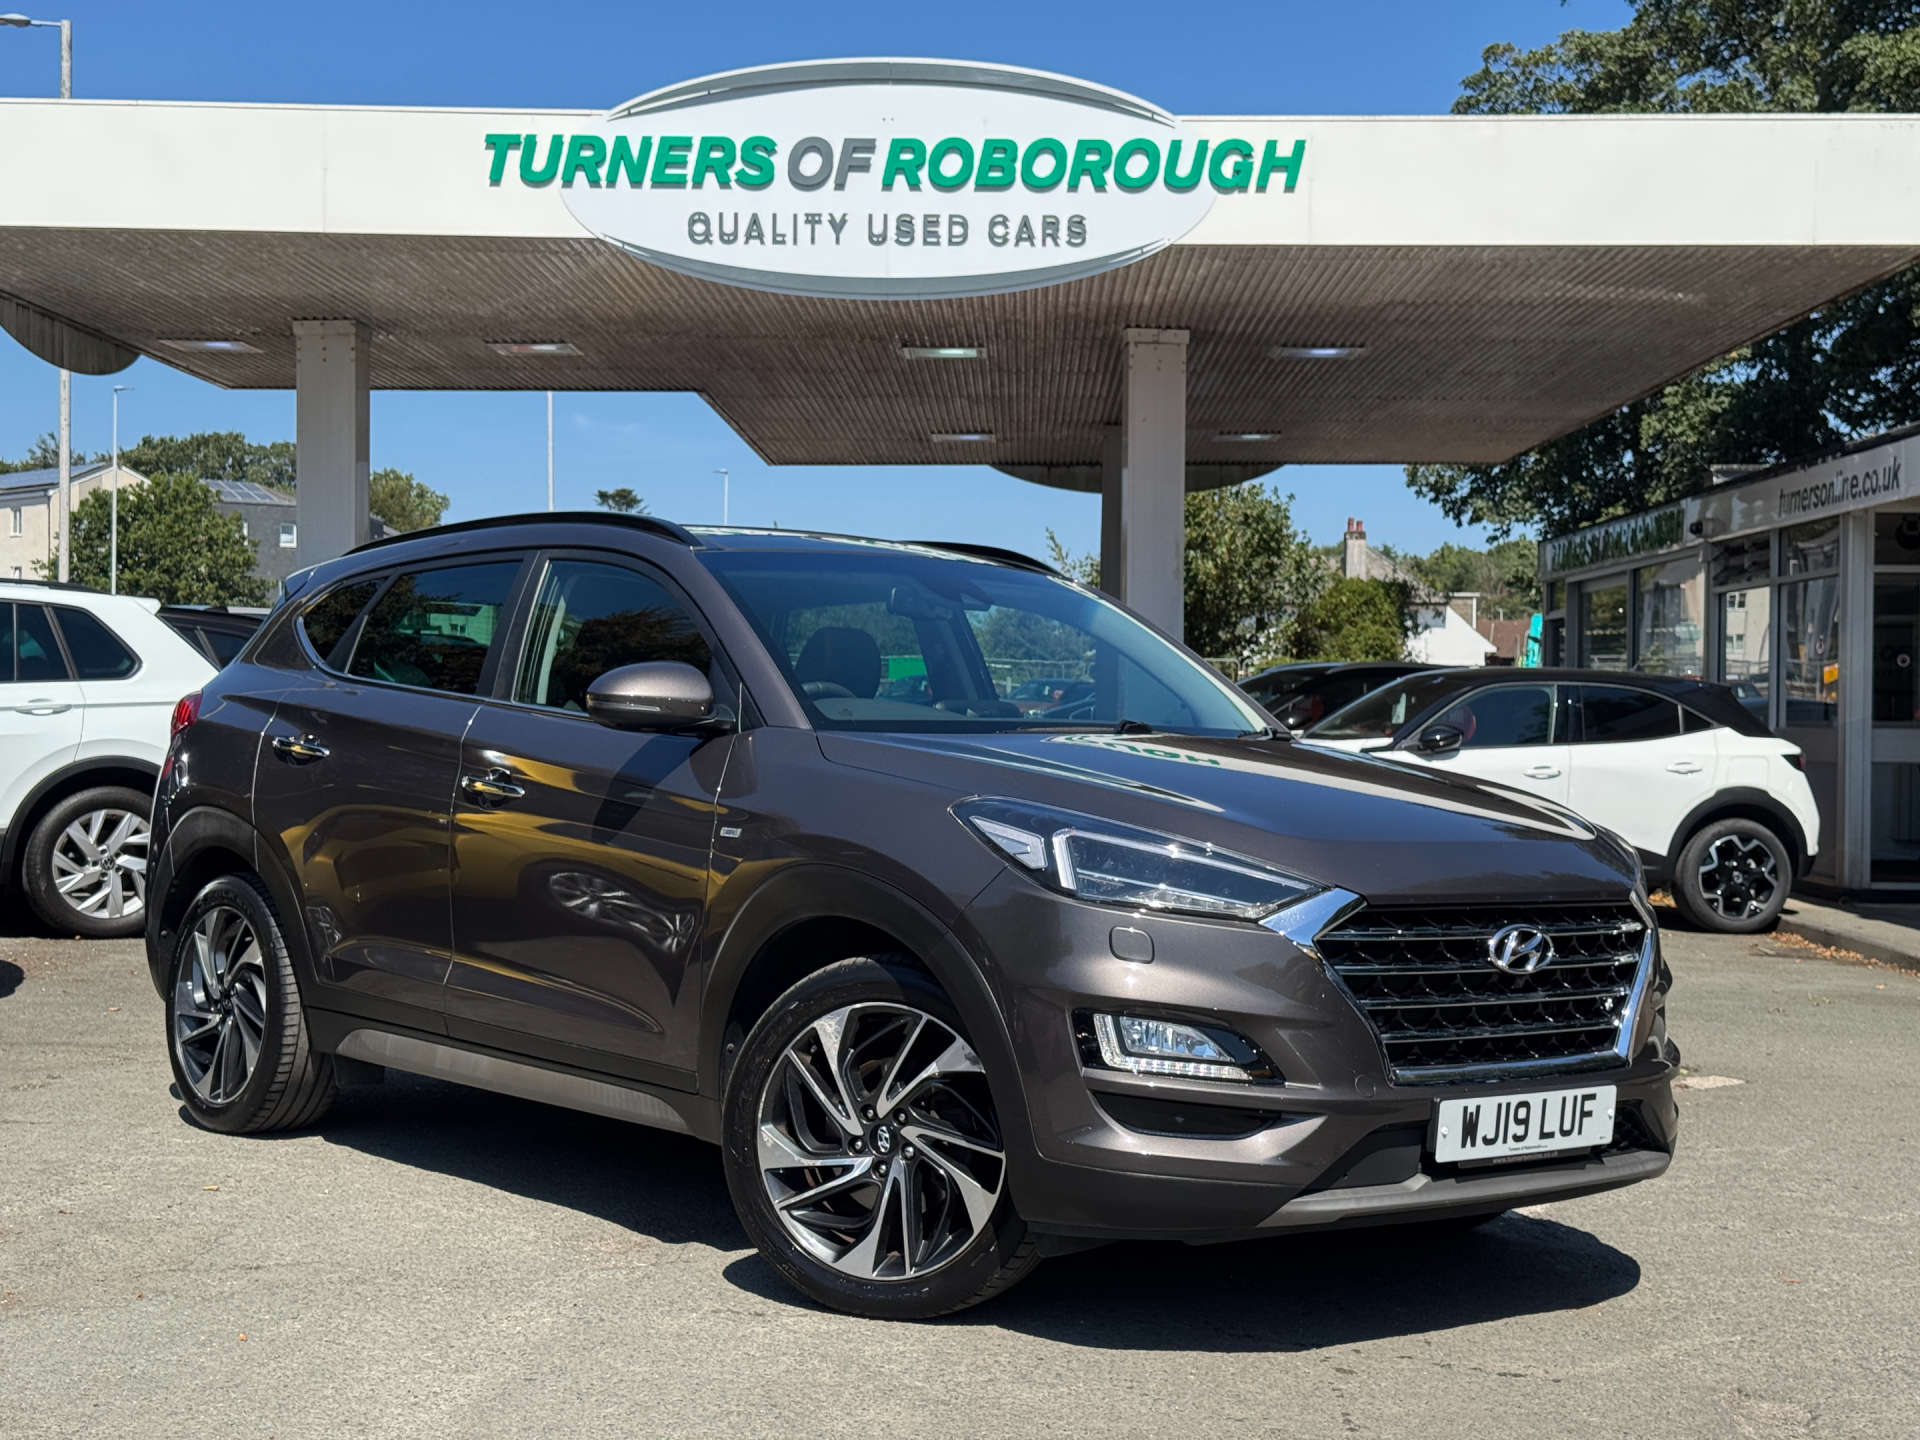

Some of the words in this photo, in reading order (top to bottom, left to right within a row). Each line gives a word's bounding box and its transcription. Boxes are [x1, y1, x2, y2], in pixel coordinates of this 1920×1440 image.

[485, 134, 777, 189] TURNERS
[787, 136, 876, 192] OF
[882, 137, 1306, 194] ROBOROUGH
[687, 212, 848, 247] QUALITY
[868, 214, 969, 247] USED
[987, 214, 1088, 248] CARS
[1460, 1100, 1531, 1149] WJ19
[1538, 1093, 1597, 1140] LUF
